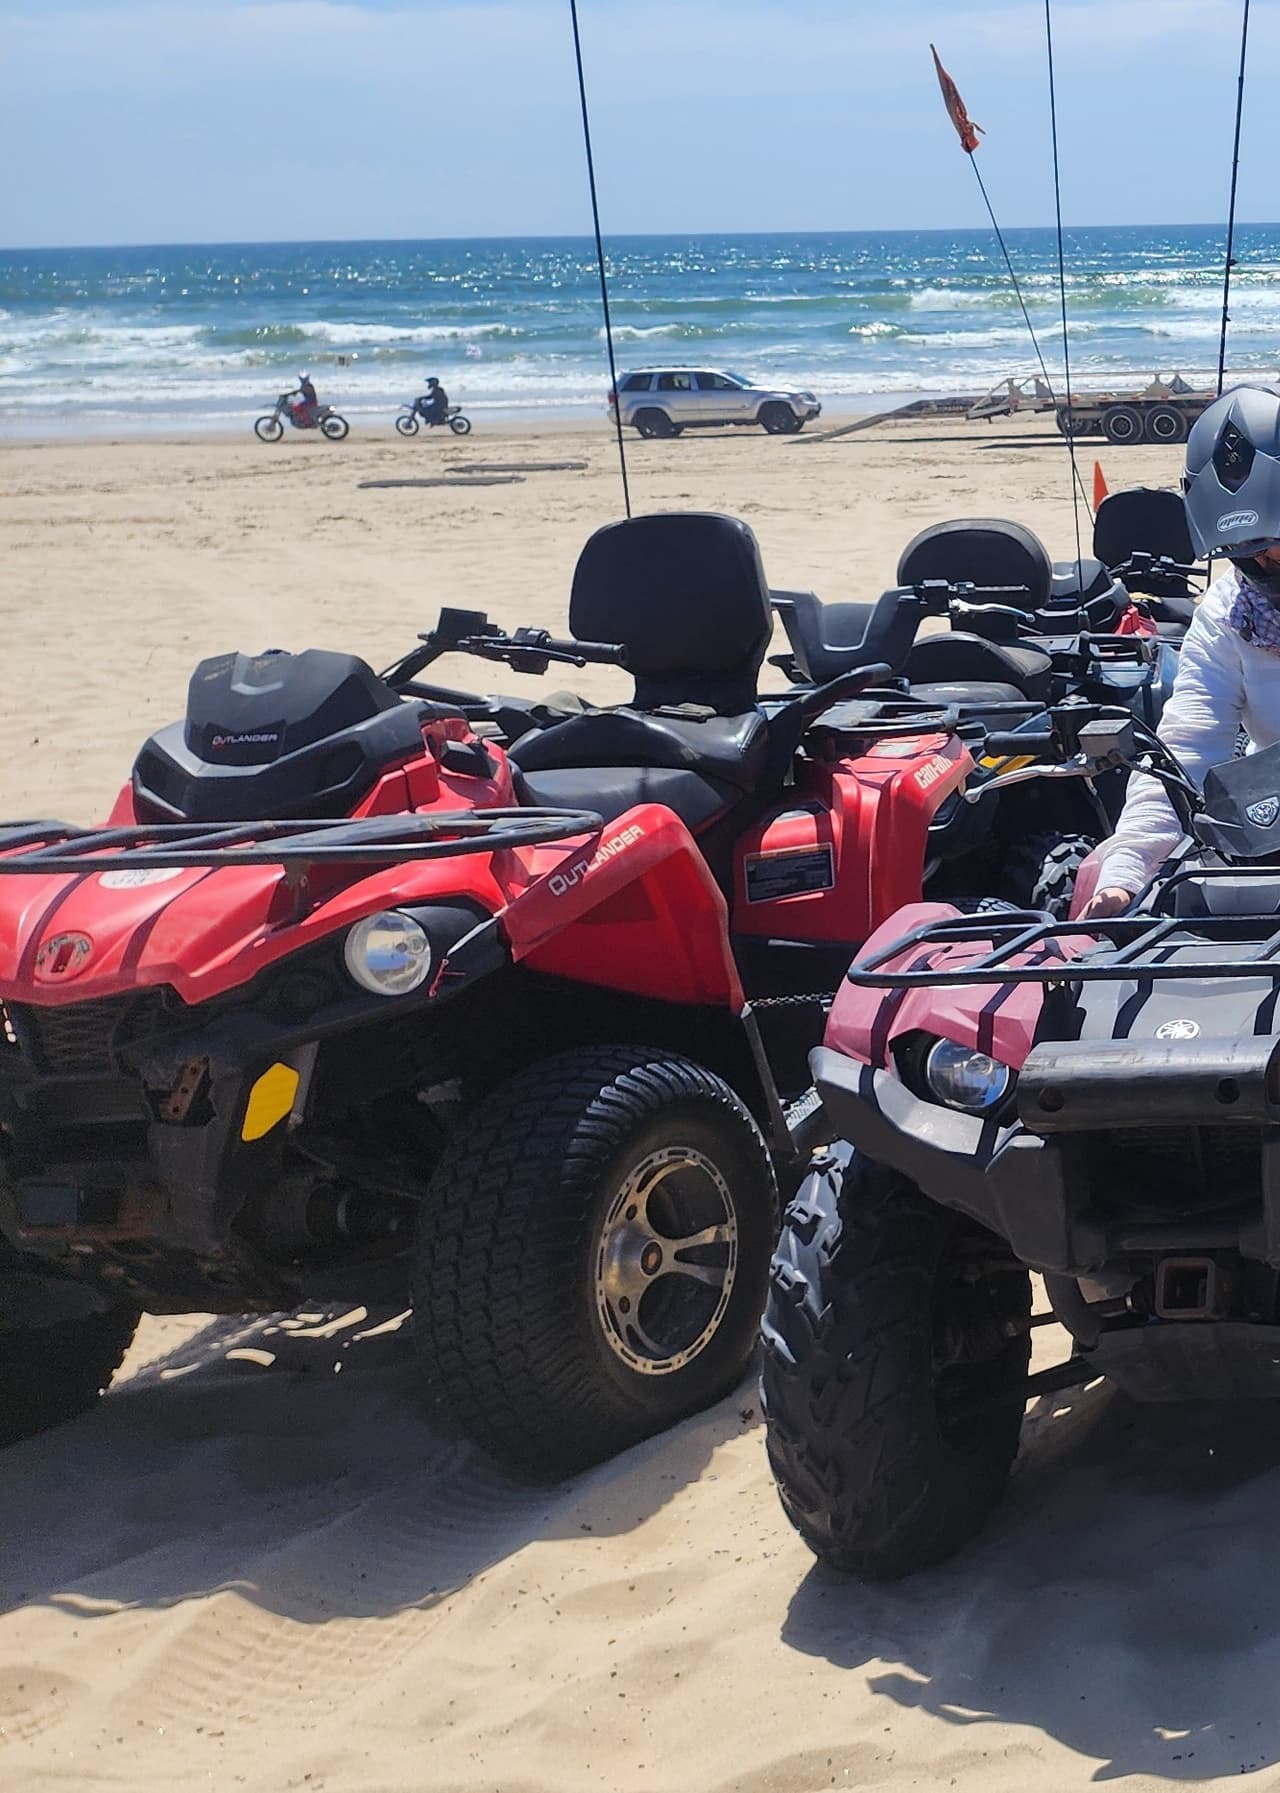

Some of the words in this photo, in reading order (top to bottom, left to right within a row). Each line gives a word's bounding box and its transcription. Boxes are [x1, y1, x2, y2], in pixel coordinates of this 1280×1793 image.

[211, 733, 278, 745] OUTLANDER
[914, 754, 953, 789] can-am
[547, 824, 645, 896] OUTLANDER
